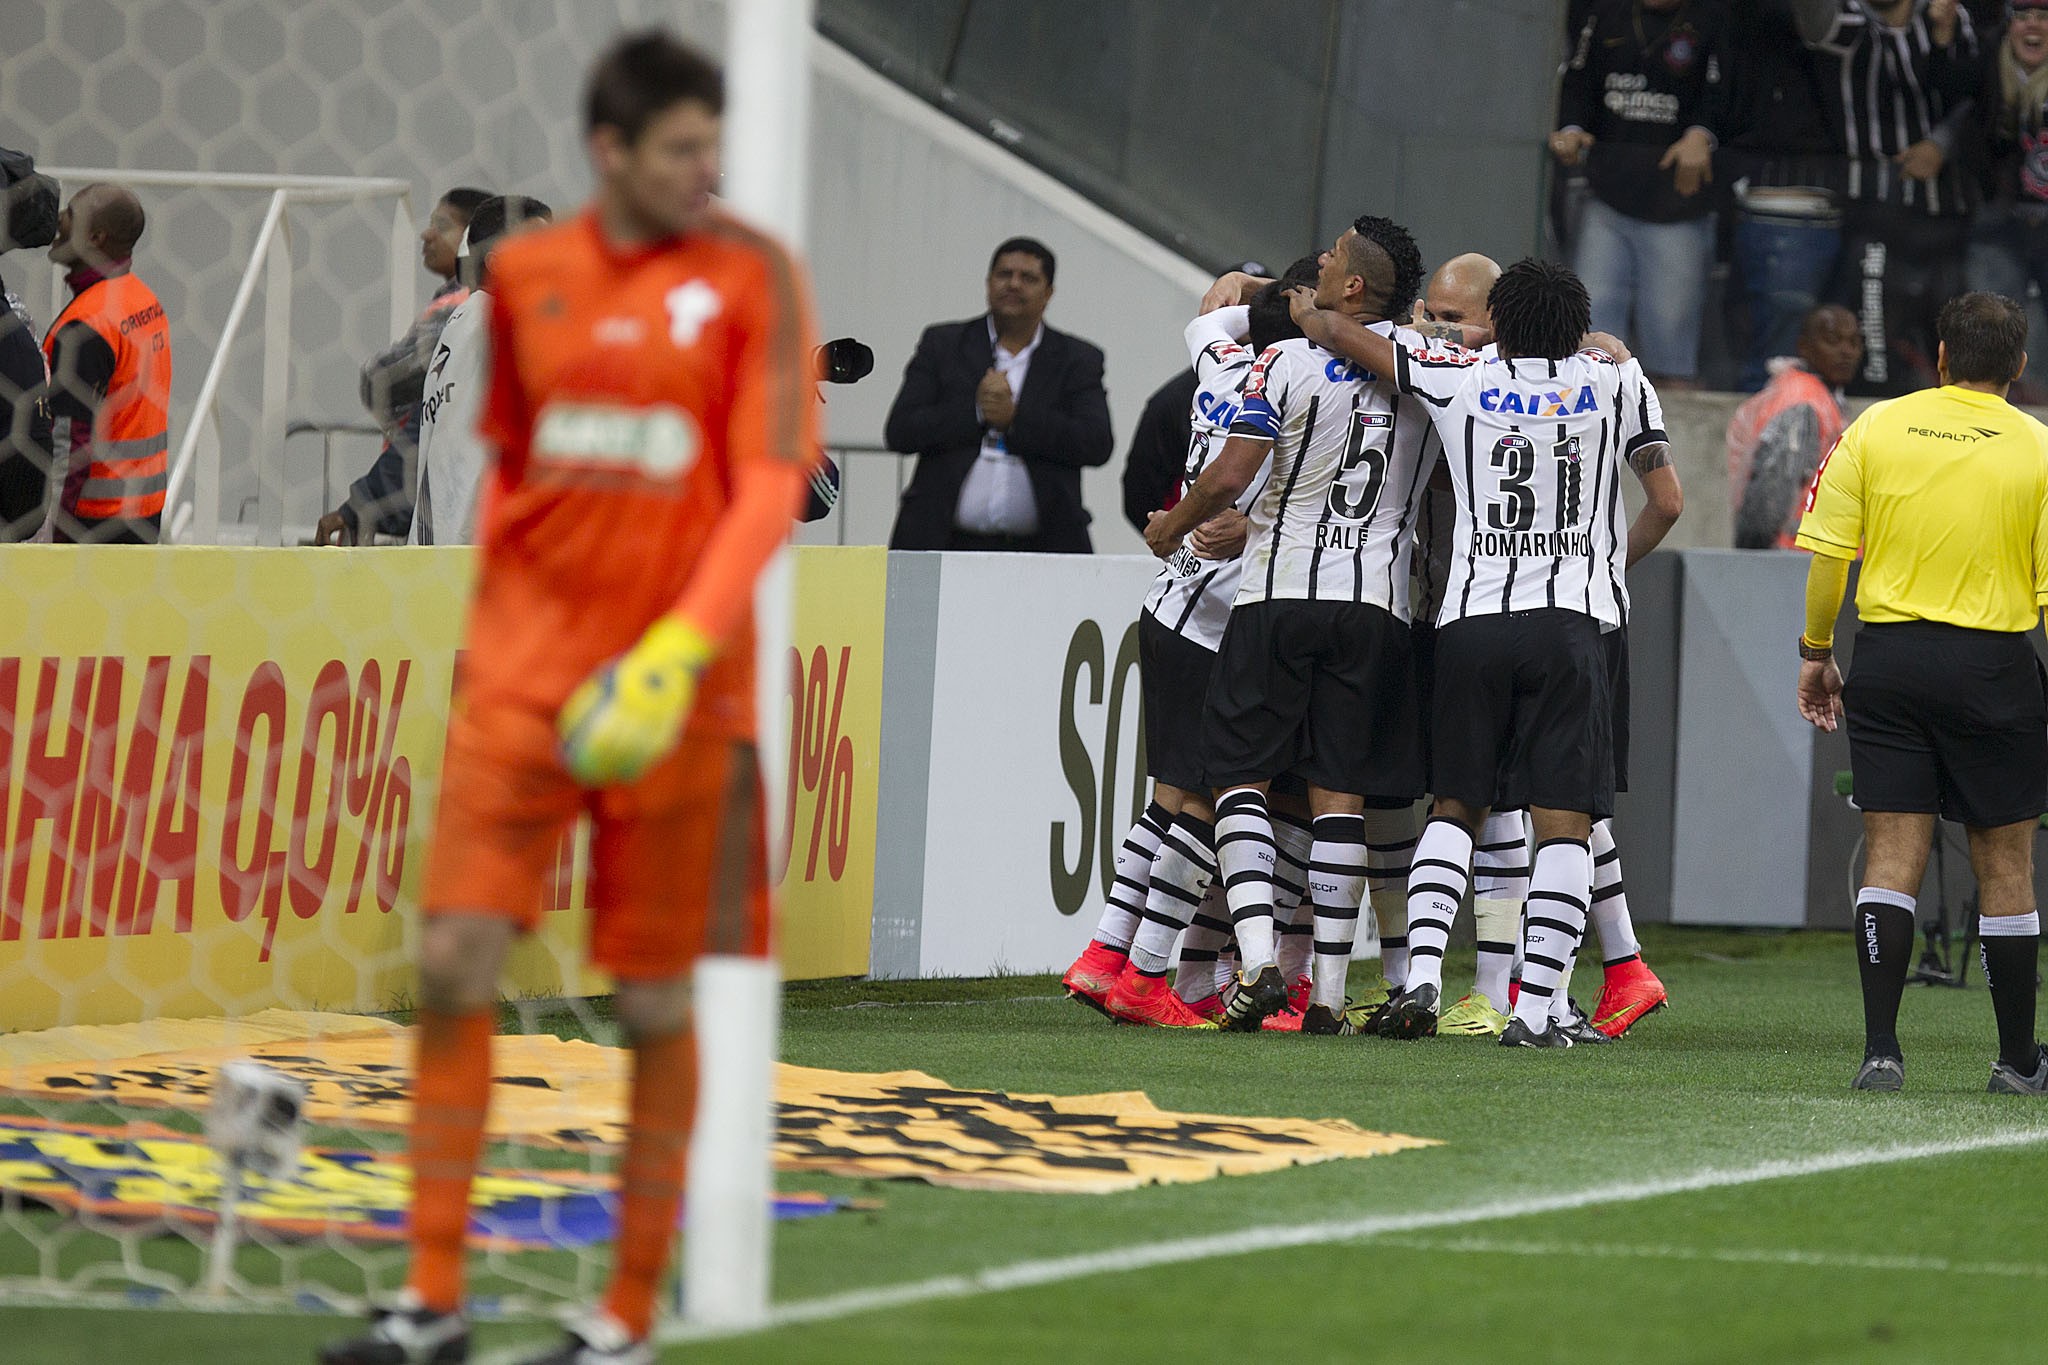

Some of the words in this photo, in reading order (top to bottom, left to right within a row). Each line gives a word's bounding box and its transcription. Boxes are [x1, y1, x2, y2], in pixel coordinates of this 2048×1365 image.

[1479, 385, 1598, 417] CAIXA
[1907, 427, 1980, 443] PENALTY
[1328, 411, 1394, 521] 5
[1487, 434, 1581, 531] 31
[1472, 531, 1591, 557] ROMARINHO
[219, 658, 411, 962] 0,0%
[1310, 881, 1338, 893] SCCP
[1865, 912, 1880, 964] PENALTY
